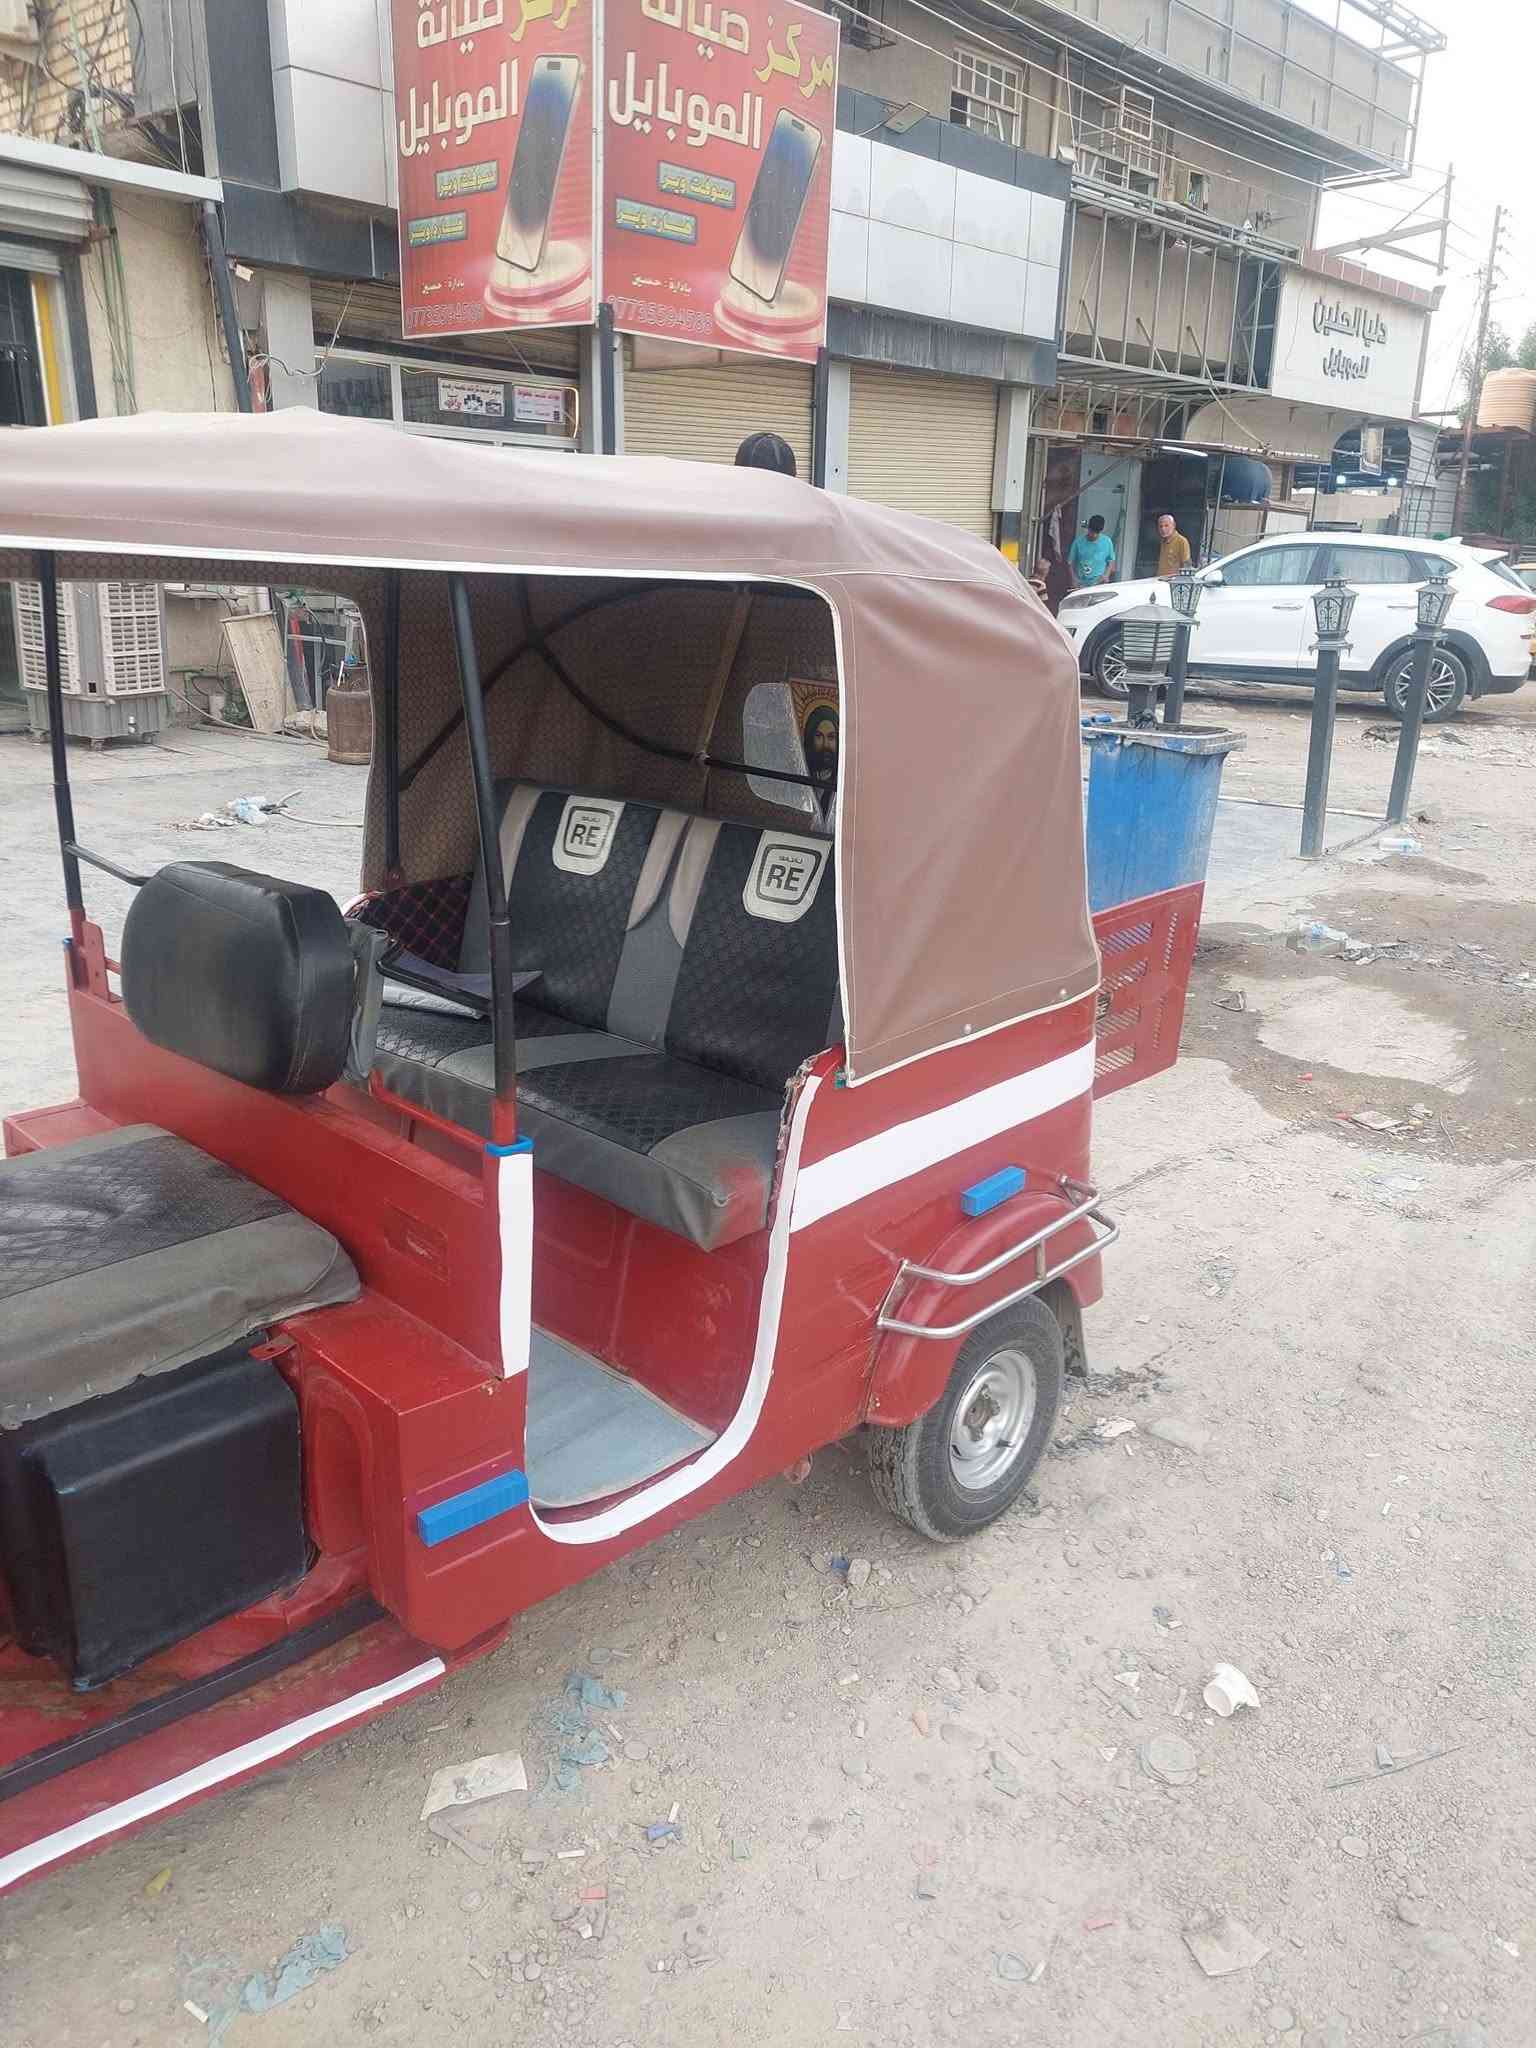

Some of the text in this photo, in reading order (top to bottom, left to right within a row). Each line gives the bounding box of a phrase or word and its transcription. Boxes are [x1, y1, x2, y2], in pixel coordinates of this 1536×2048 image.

[754, 15, 834, 98] مركز
[399, 56, 520, 157] الموبايل
[608, 51, 764, 149] الموبايل
[570, 823, 601, 847] RE
[766, 863, 804, 892] RE
